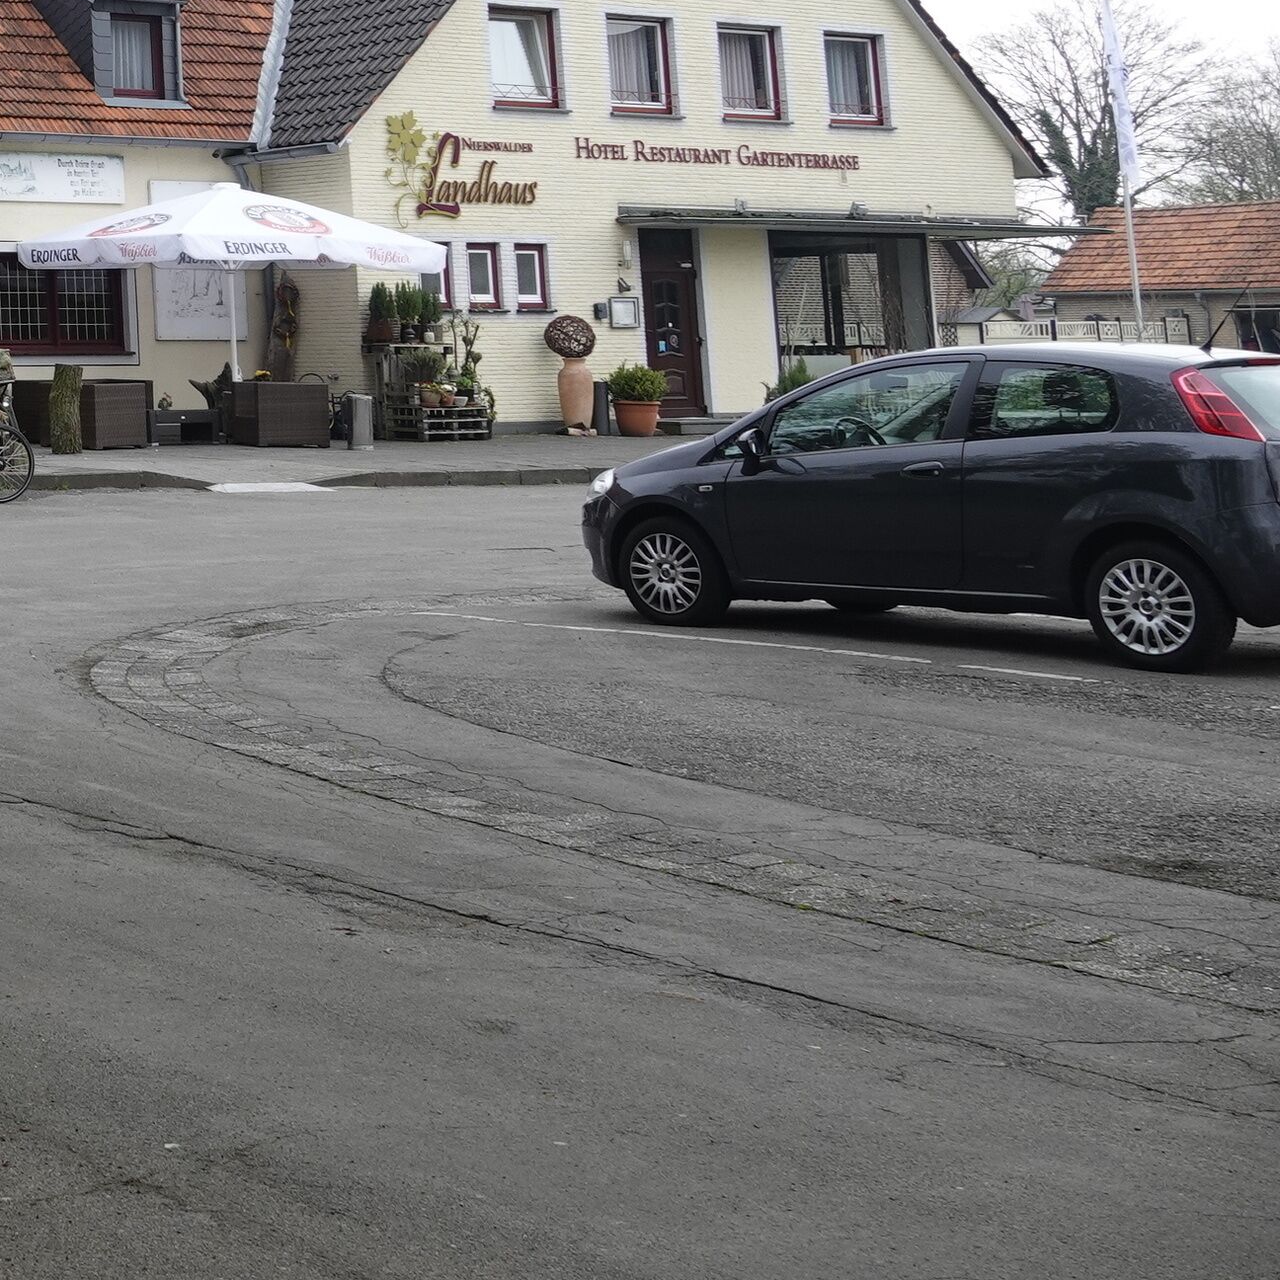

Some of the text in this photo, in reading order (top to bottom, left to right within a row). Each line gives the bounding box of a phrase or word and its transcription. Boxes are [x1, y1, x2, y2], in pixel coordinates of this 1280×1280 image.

[461, 137, 534, 153] NIERSWALDER
[574, 137, 860, 170] HOTEL RESTAURANT GARTENTERRASSE
[416, 131, 538, 218] Landhaus
[31, 248, 81, 263] ERDINGER
[118, 241, 158, 261] Weißbier
[224, 240, 293, 256] ERDINGER
[366, 246, 413, 267] Weißbier
